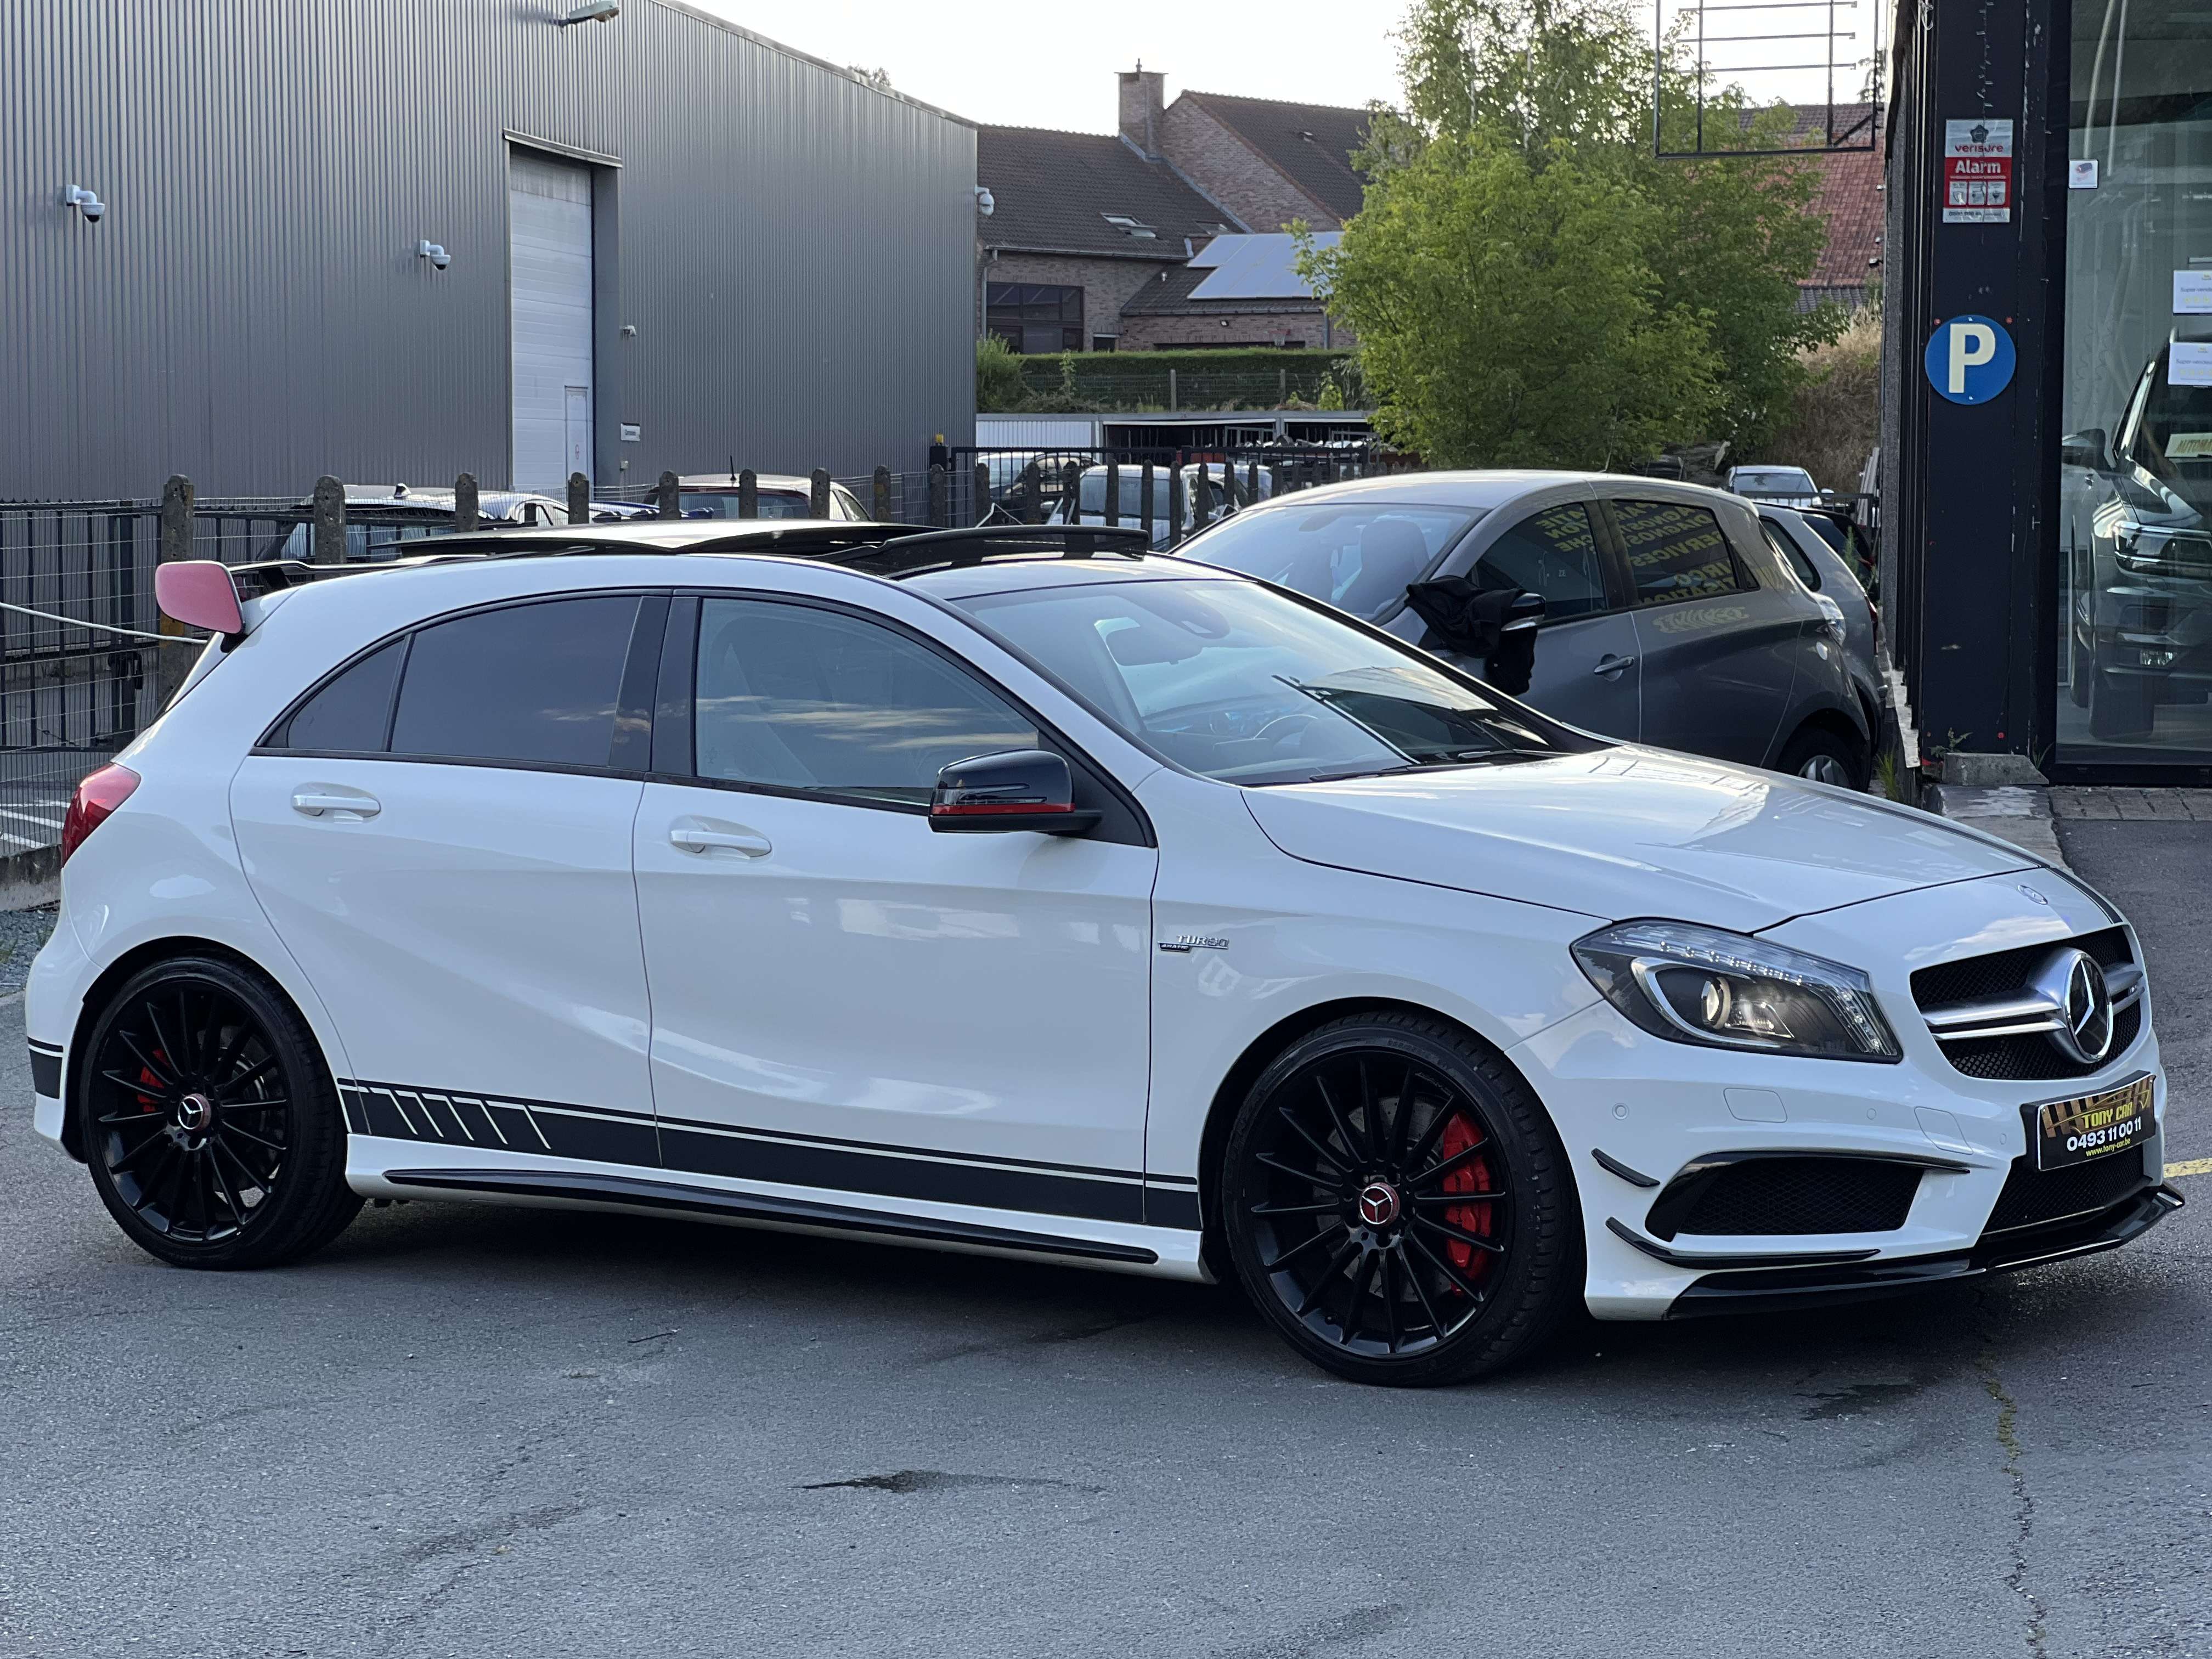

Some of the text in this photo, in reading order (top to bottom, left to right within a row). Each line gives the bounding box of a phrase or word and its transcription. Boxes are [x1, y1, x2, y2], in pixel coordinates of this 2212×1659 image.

[1955, 144, 2004, 153] verisure
[1955, 159, 2001, 174] Alarm
[1949, 323, 1996, 393] P
[1176, 935, 1229, 946] TURBO
[2082, 1102, 2133, 1129] TONY CAR
[2067, 1116, 2141, 1152] 0493 11 00 11
[2086, 1137, 2131, 1156] www.tony-car.be
